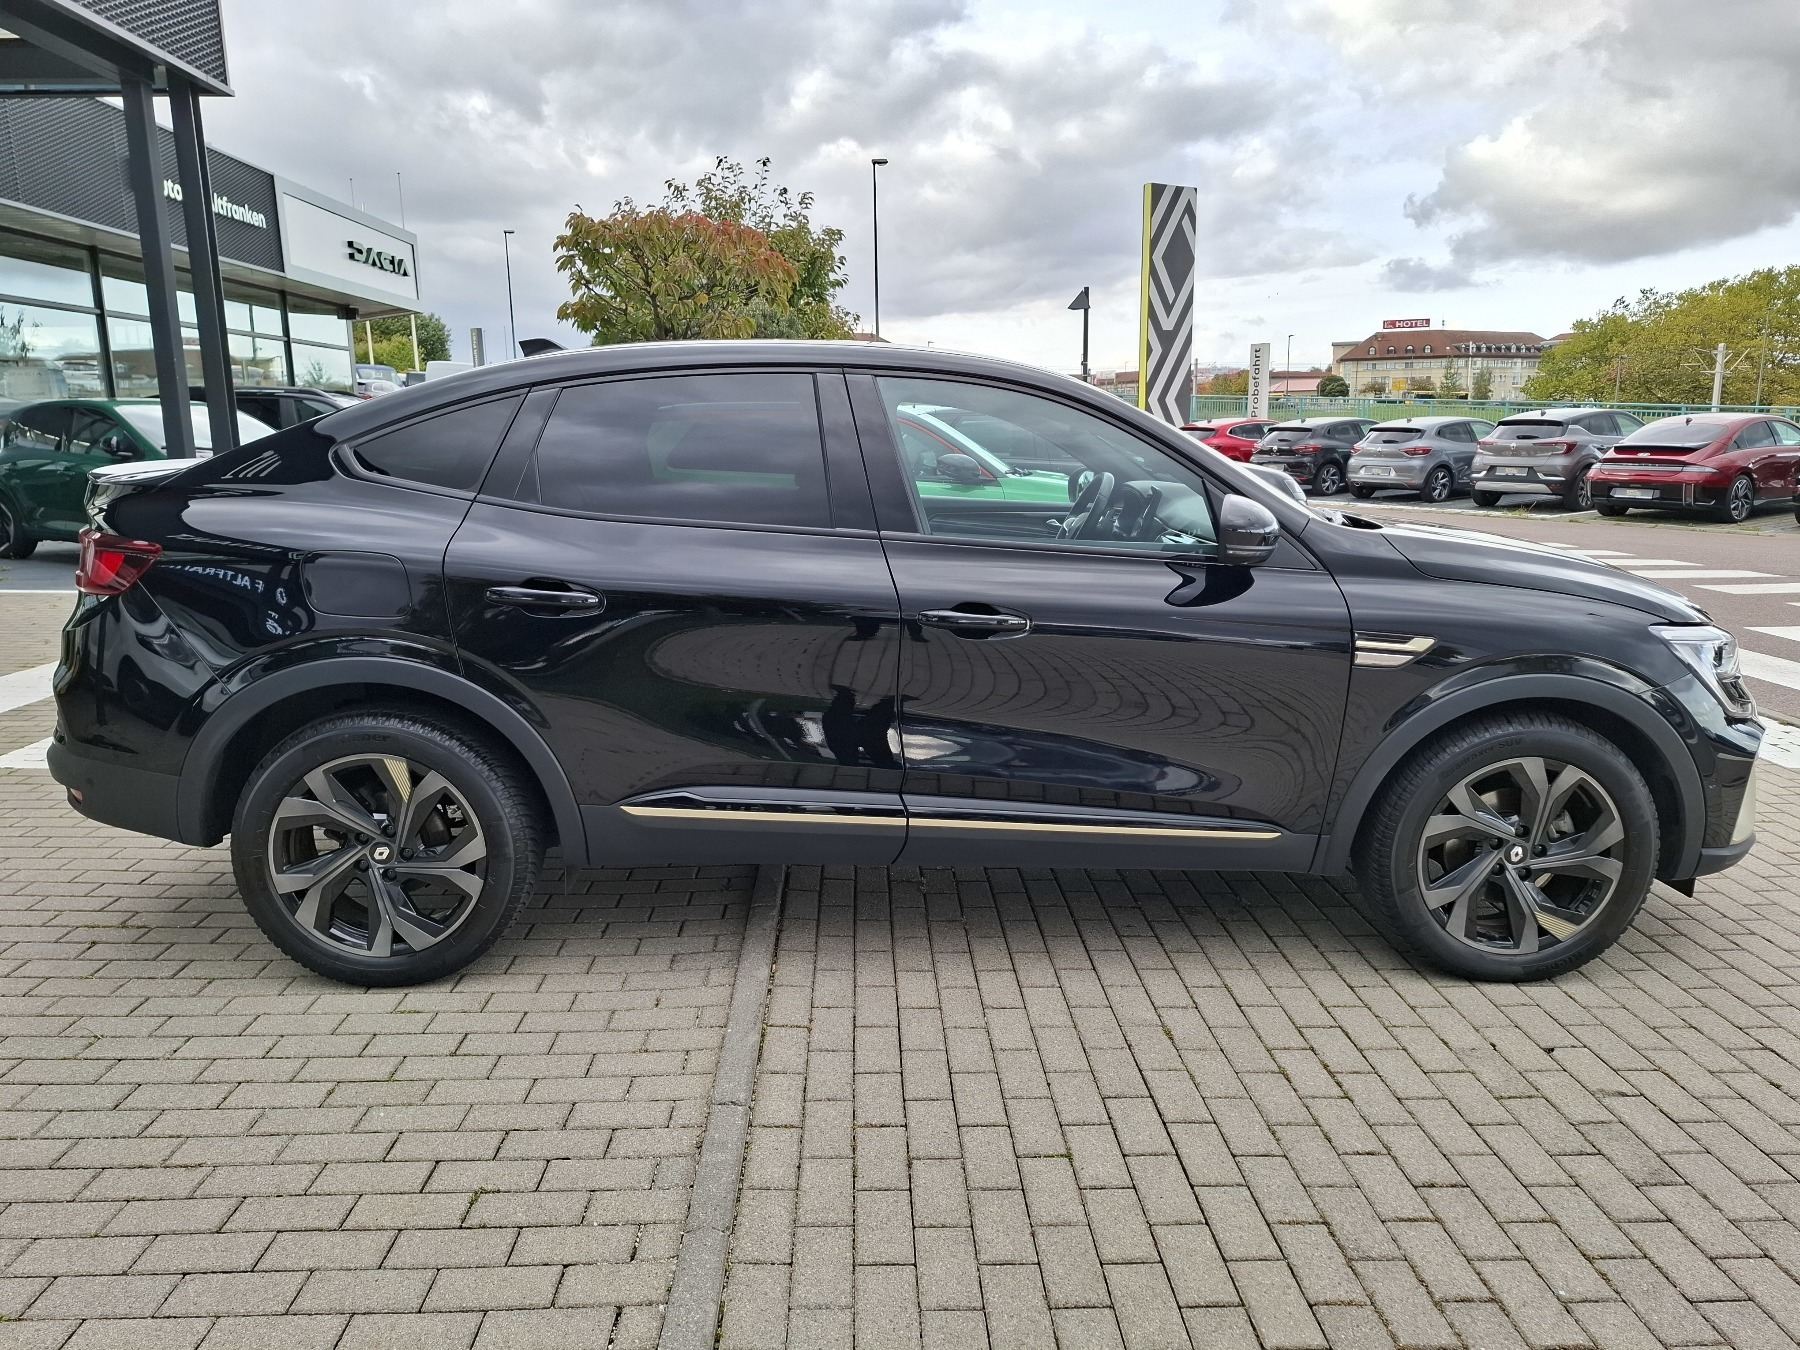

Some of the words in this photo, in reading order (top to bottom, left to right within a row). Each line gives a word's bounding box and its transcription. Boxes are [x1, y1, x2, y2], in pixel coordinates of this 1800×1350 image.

[212, 192, 266, 228] ltfranken
[347, 241, 410, 277] DACIA
[1395, 320, 1429, 328] HOTEL
[1251, 347, 1261, 418] Probefahrt
